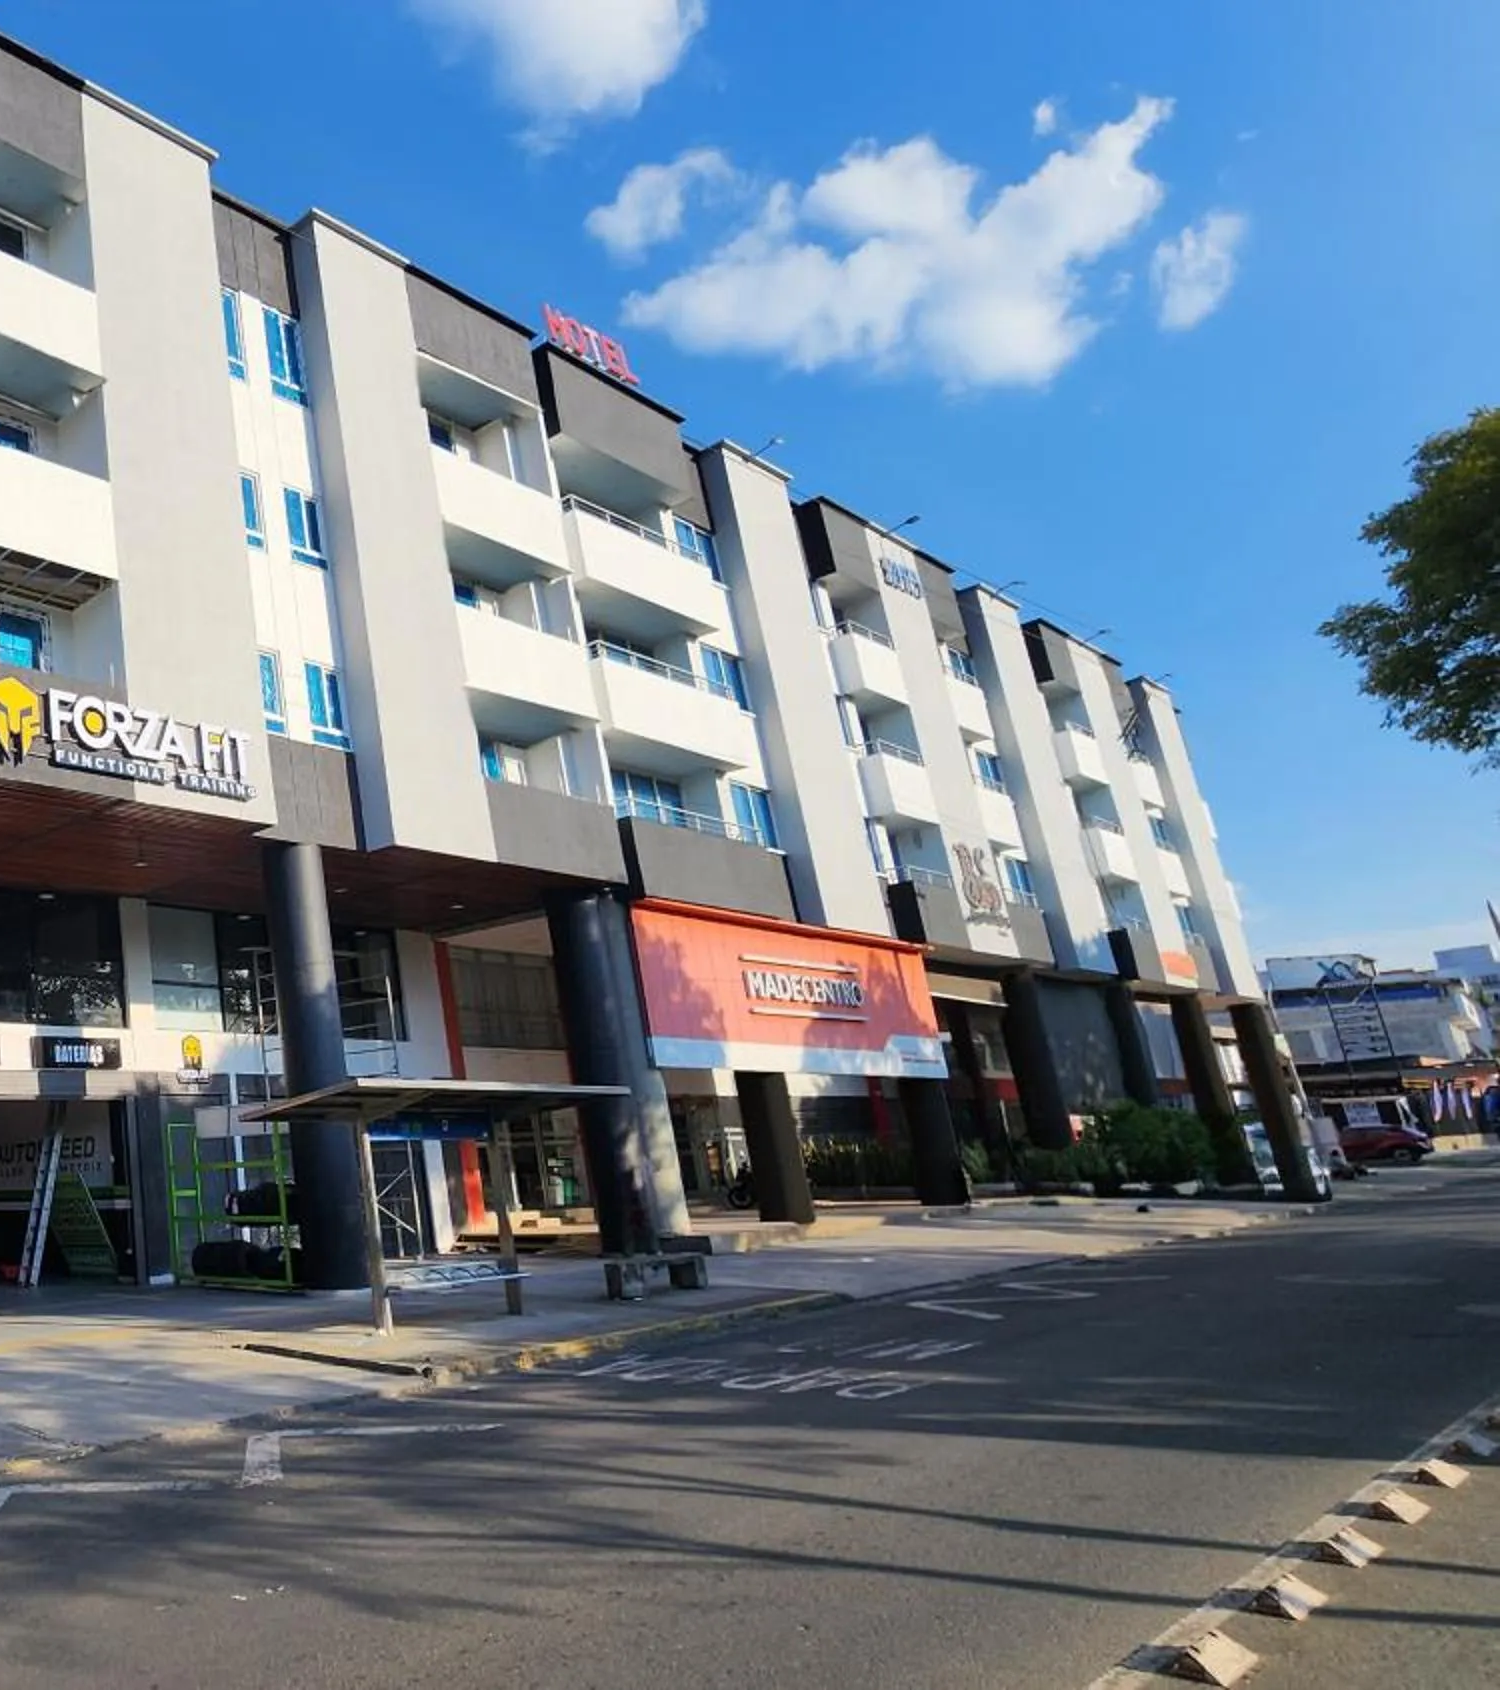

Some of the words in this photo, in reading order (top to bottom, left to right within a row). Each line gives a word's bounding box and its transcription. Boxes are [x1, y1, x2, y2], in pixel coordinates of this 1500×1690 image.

[49, 688, 196, 768] FORZA
[200, 722, 251, 785] FIT
[55, 749, 171, 782] FUNCTIONAL
[178, 771, 259, 799] TRAINING
[745, 969, 865, 1006] MADECENTRO
